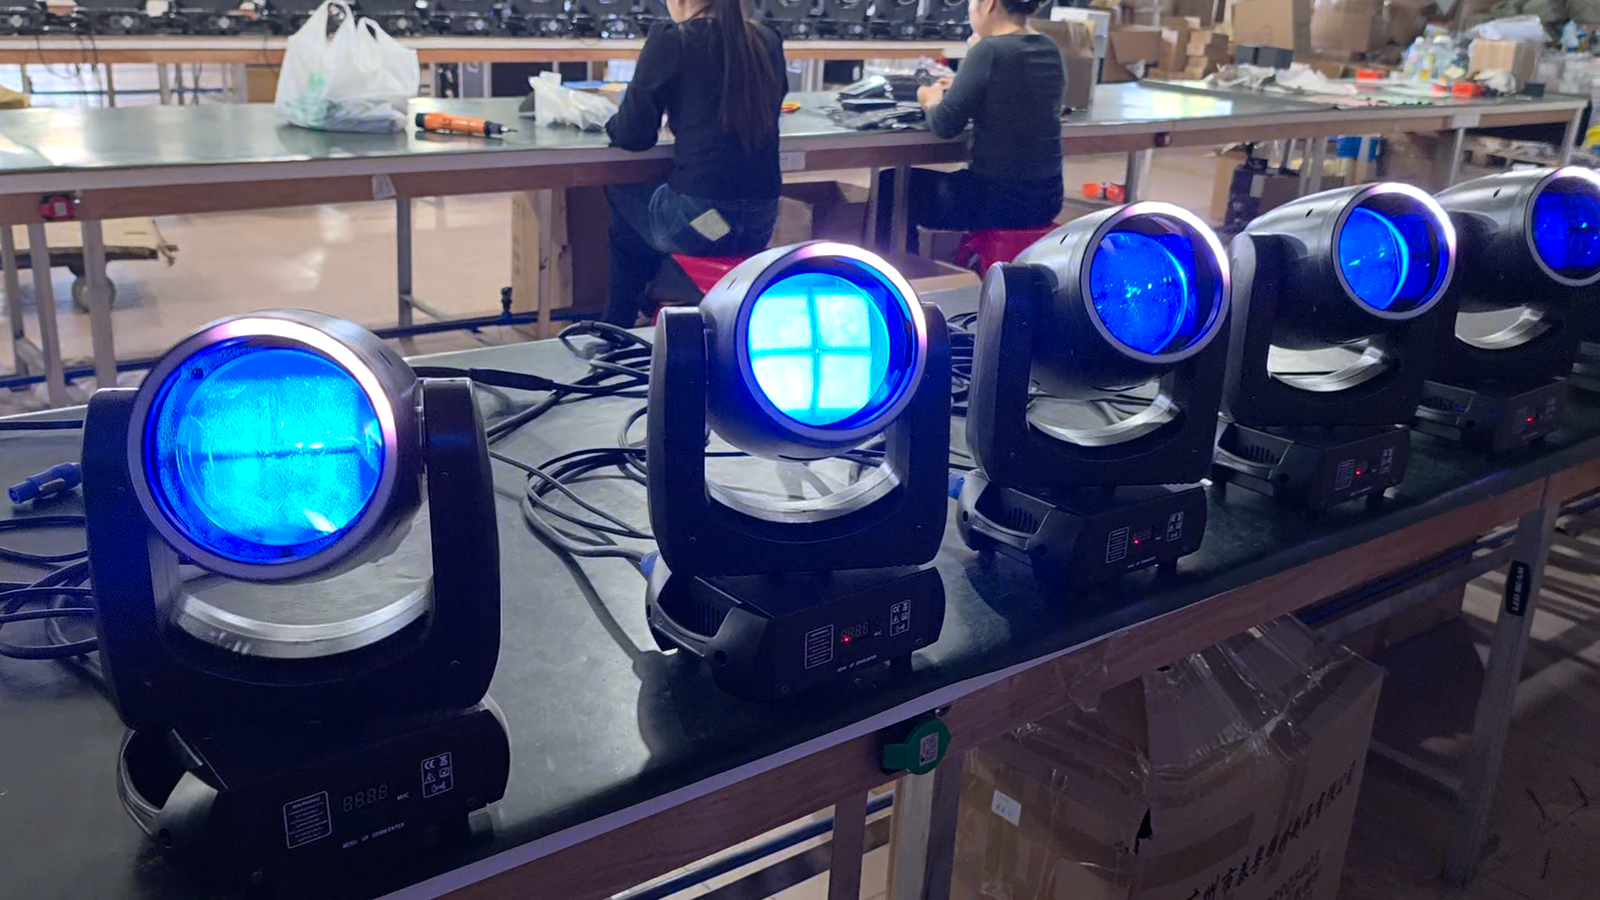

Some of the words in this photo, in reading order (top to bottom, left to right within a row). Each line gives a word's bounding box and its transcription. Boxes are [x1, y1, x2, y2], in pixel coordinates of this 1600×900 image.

[1514, 566, 1524, 593] BEAM
[1511, 593, 1520, 612] LED
[424, 759, 436, 770] CE
[396, 792, 410, 801] MIC
[361, 834, 370, 842] UP
[388, 821, 405, 833] ENTER
